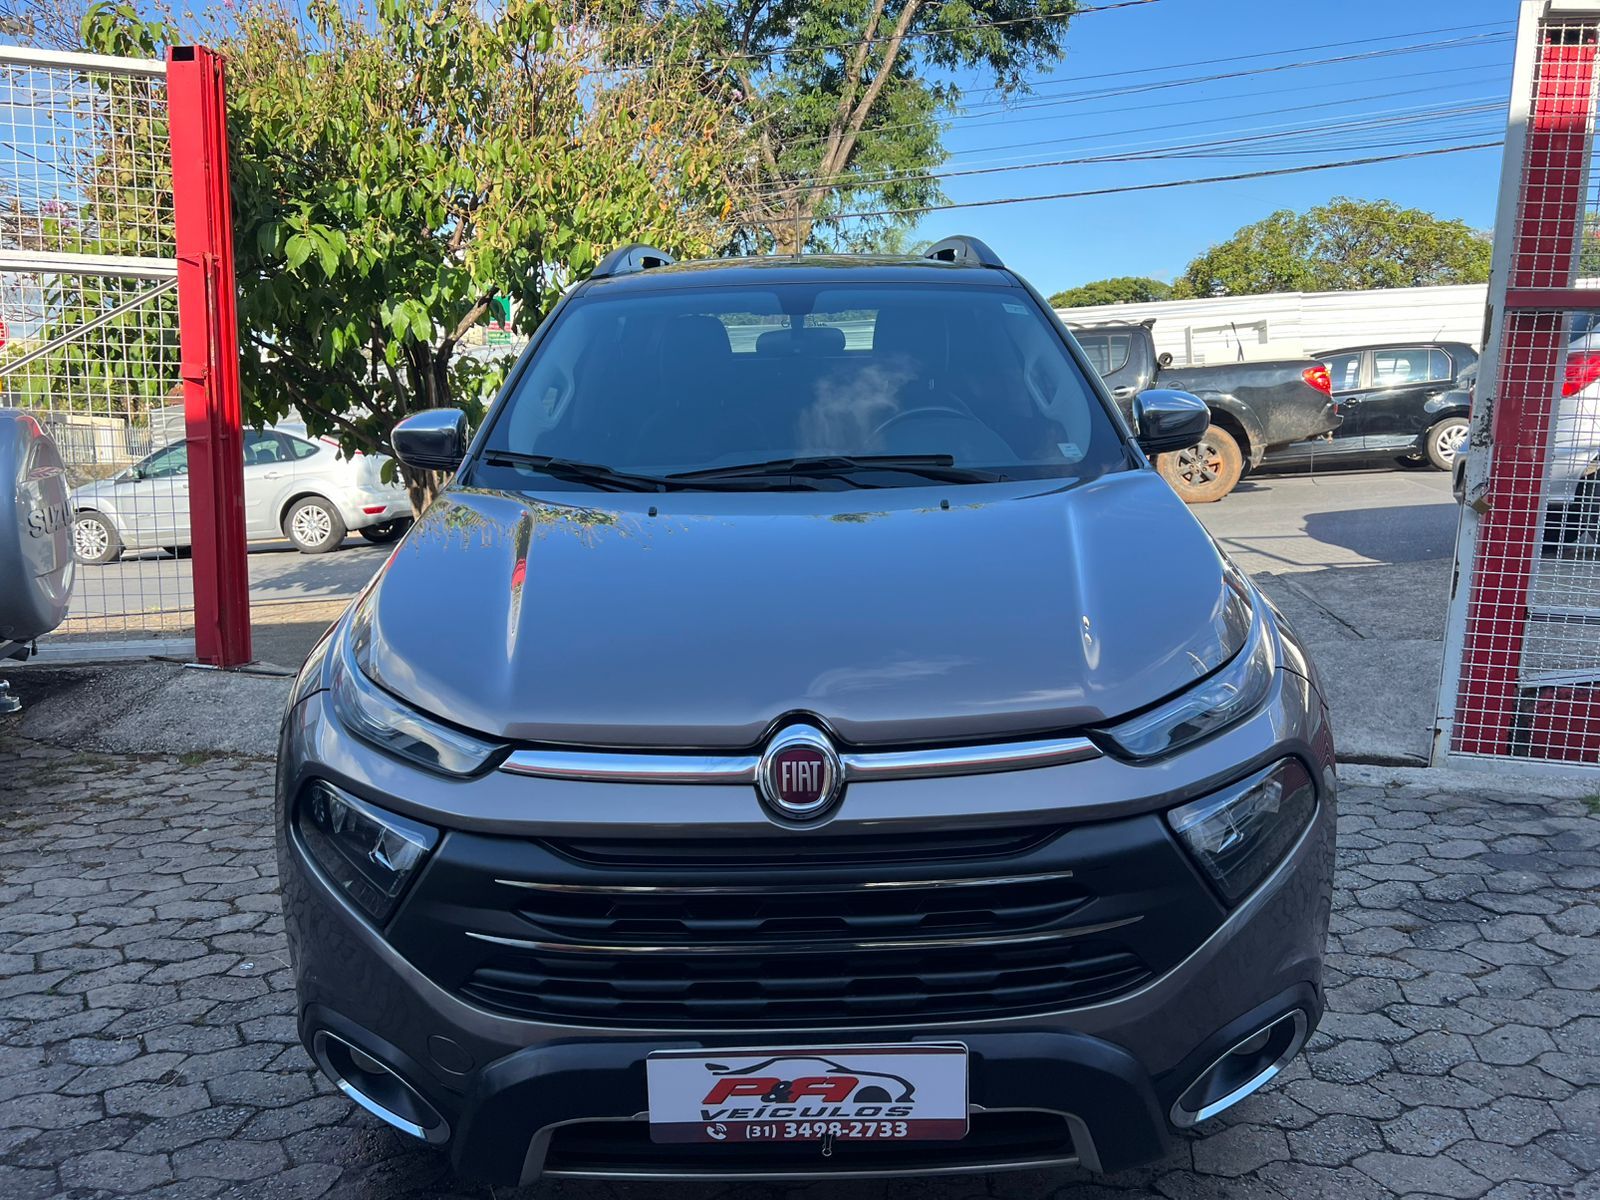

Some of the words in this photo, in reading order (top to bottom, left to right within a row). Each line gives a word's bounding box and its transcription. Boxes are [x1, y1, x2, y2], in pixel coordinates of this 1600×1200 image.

[28, 501, 73, 538] SUZU
[782, 761, 821, 792] FIAT
[702, 1077, 859, 1104] P&A
[700, 1105, 913, 1120] VEÍCULOS
[746, 1125, 777, 1138] (31)
[784, 1121, 908, 1138] 3498-2733
